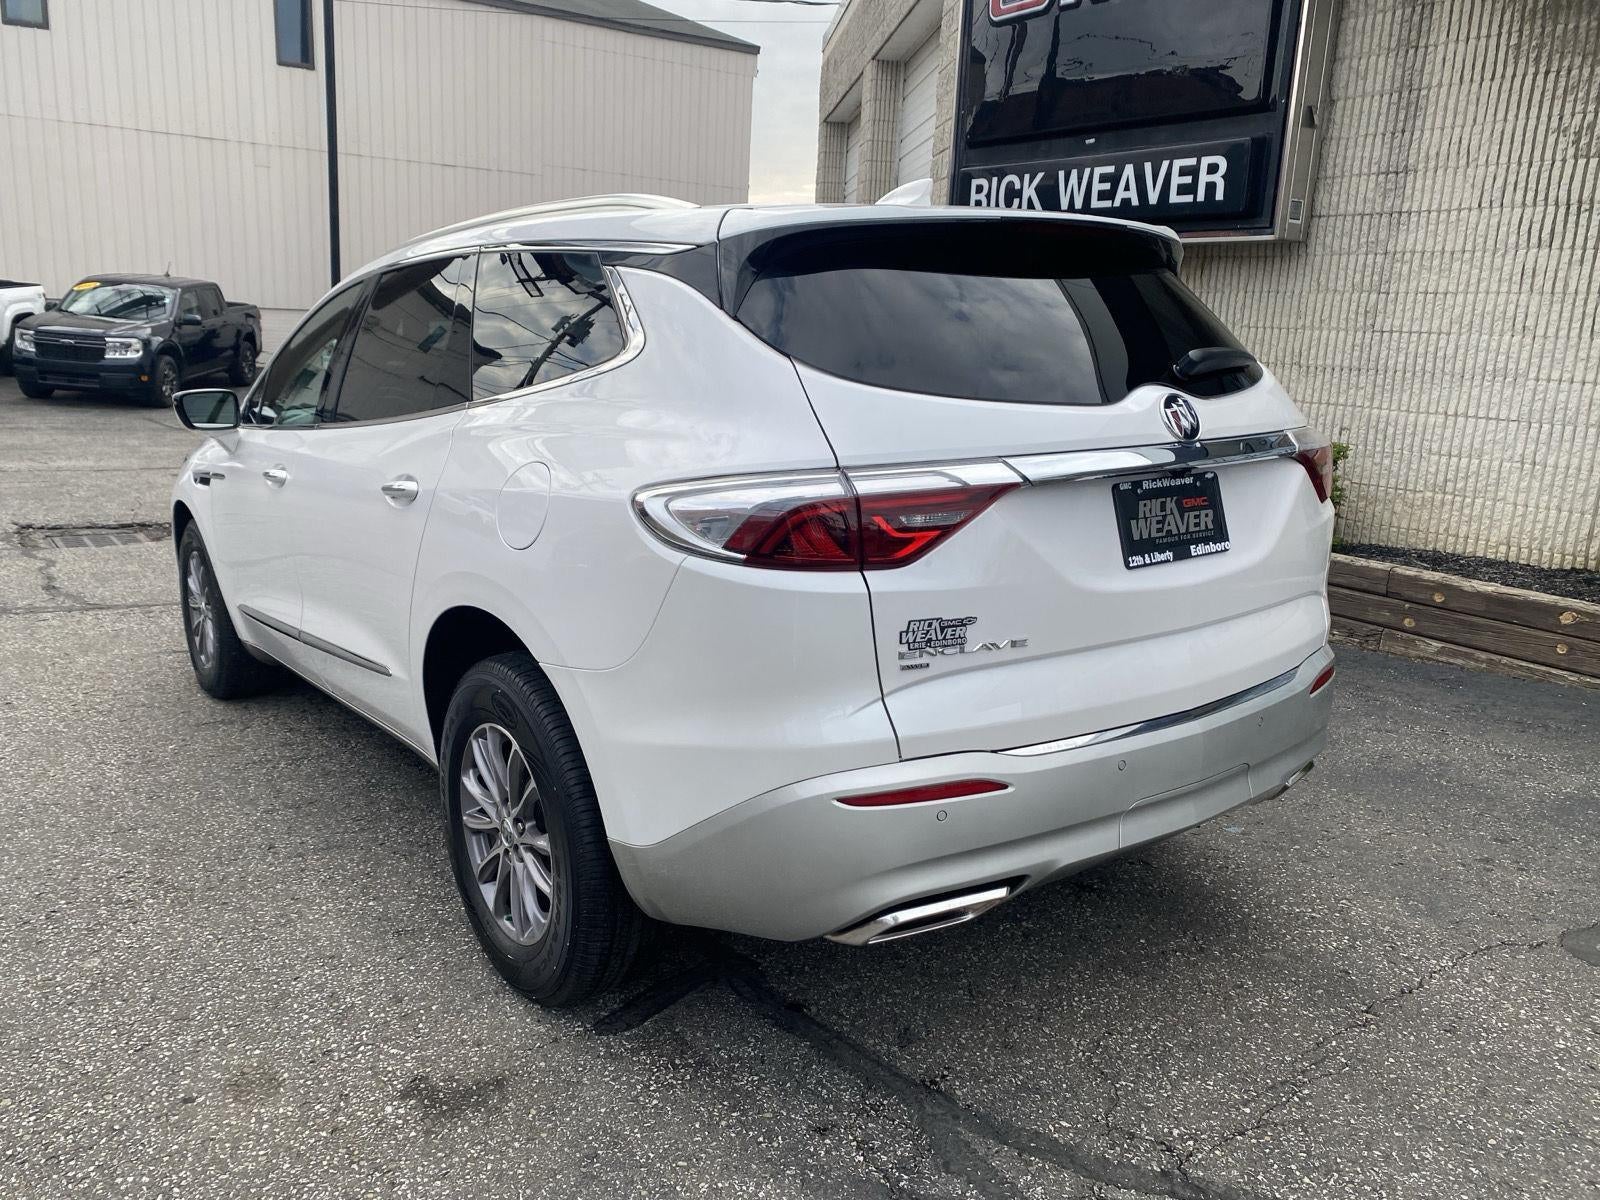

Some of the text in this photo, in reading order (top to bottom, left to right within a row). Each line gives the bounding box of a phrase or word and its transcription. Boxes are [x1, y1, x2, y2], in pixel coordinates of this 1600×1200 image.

[970, 155, 1228, 210] RICK WEAVER
[1142, 476, 1194, 490] RickWeaver
[1138, 497, 1178, 518] RICK
[1182, 496, 1209, 507] GMC
[1130, 509, 1214, 540] WEAVER
[1190, 541, 1231, 556] Edinboro
[1128, 550, 1174, 567] 12th & Liberty
[908, 619, 941, 631] RICK
[940, 619, 963, 627] GMC
[900, 626, 967, 644] WEAVER
[898, 639, 1028, 660] ENCLAVE
[909, 637, 967, 650] ERIE EDINBORO
